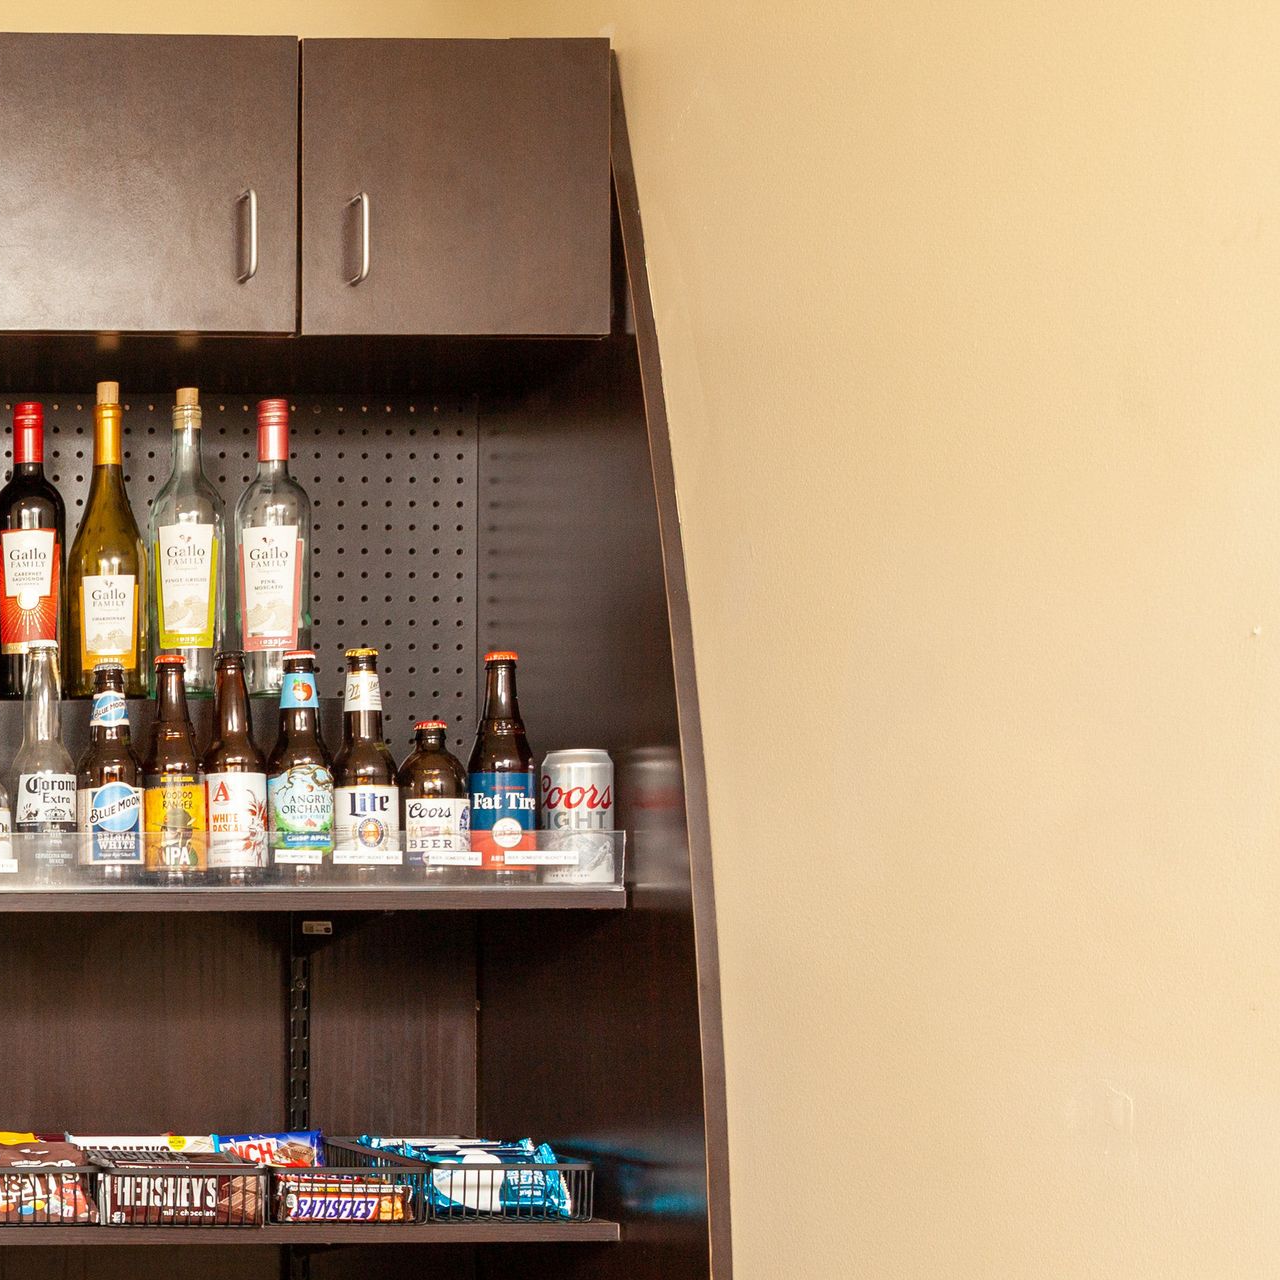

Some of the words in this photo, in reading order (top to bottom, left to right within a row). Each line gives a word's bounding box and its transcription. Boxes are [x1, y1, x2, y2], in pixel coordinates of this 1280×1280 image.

[166, 546, 205, 558] Gallo
[249, 548, 289, 561] Gallo
[10, 560, 46, 569] FAMILY
[168, 558, 204, 566] FAMILY
[43, 793, 70, 804] Extra
[161, 790, 193, 800] VOODOO
[289, 795, 328, 804] ANGRY
[163, 800, 193, 809] RANGER
[349, 792, 389, 816] Lite
[473, 793, 502, 810] Fat
[508, 792, 535, 810] Tire
[281, 803, 331, 814] ORCHARD
[408, 802, 452, 818] Coors
[97, 840, 136, 850] WHITE
[410, 839, 453, 848] BEER
[116, 1177, 217, 1207] HERSHEY'S
